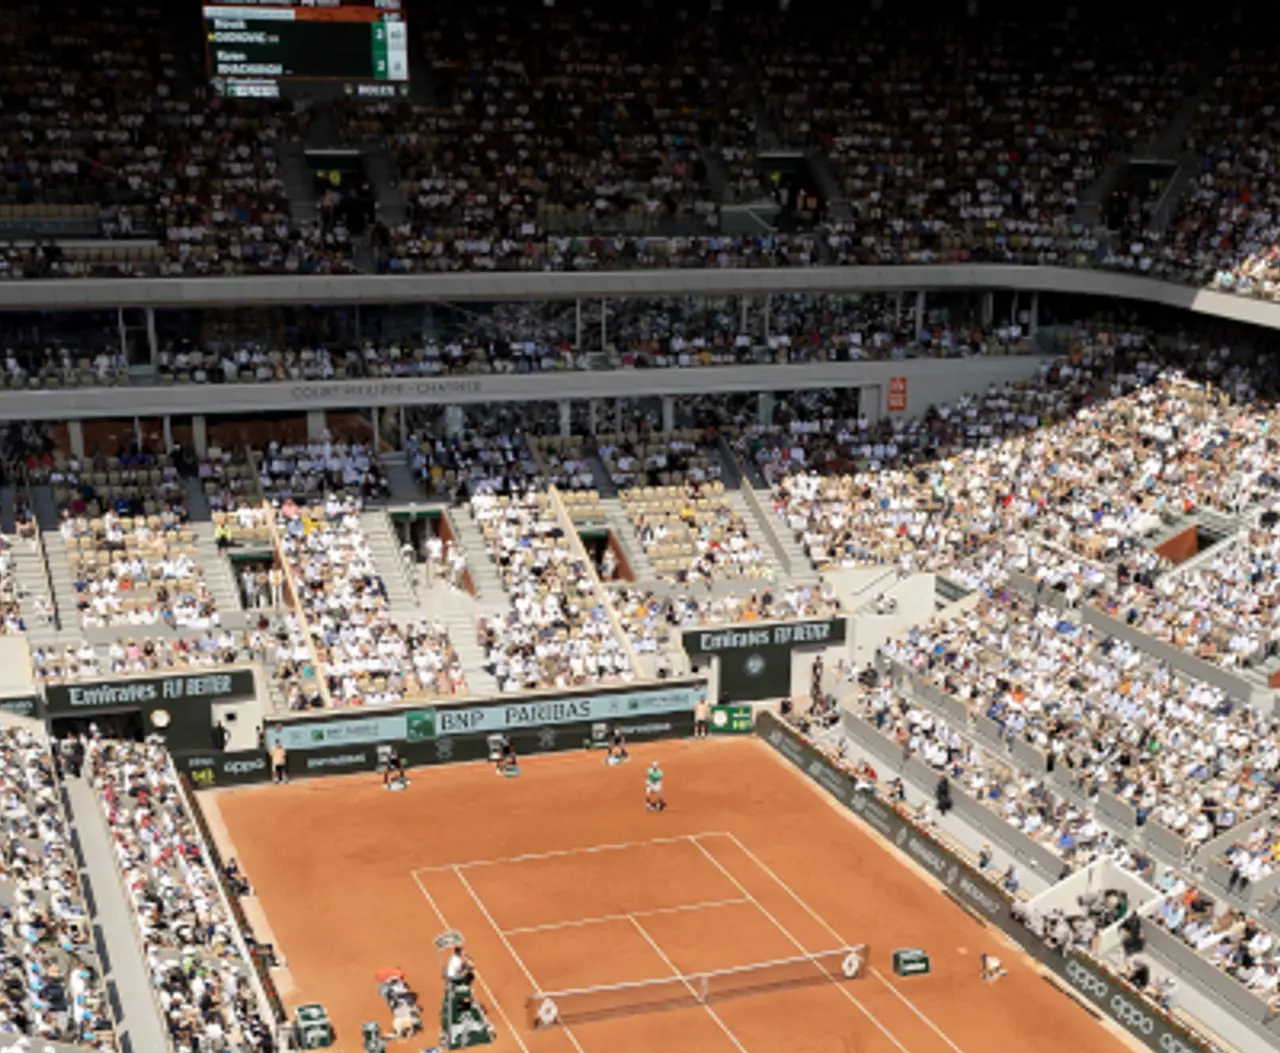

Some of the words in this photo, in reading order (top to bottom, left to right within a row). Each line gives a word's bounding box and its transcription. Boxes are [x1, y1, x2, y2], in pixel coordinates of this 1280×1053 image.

[700, 630, 769, 650] Emirates
[68, 684, 156, 706] Emirates
[441, 710, 485, 731] BNP
[505, 700, 591, 724] PARIBAS
[1066, 959, 1109, 999] oppo
[1110, 994, 1154, 1035] oppo
